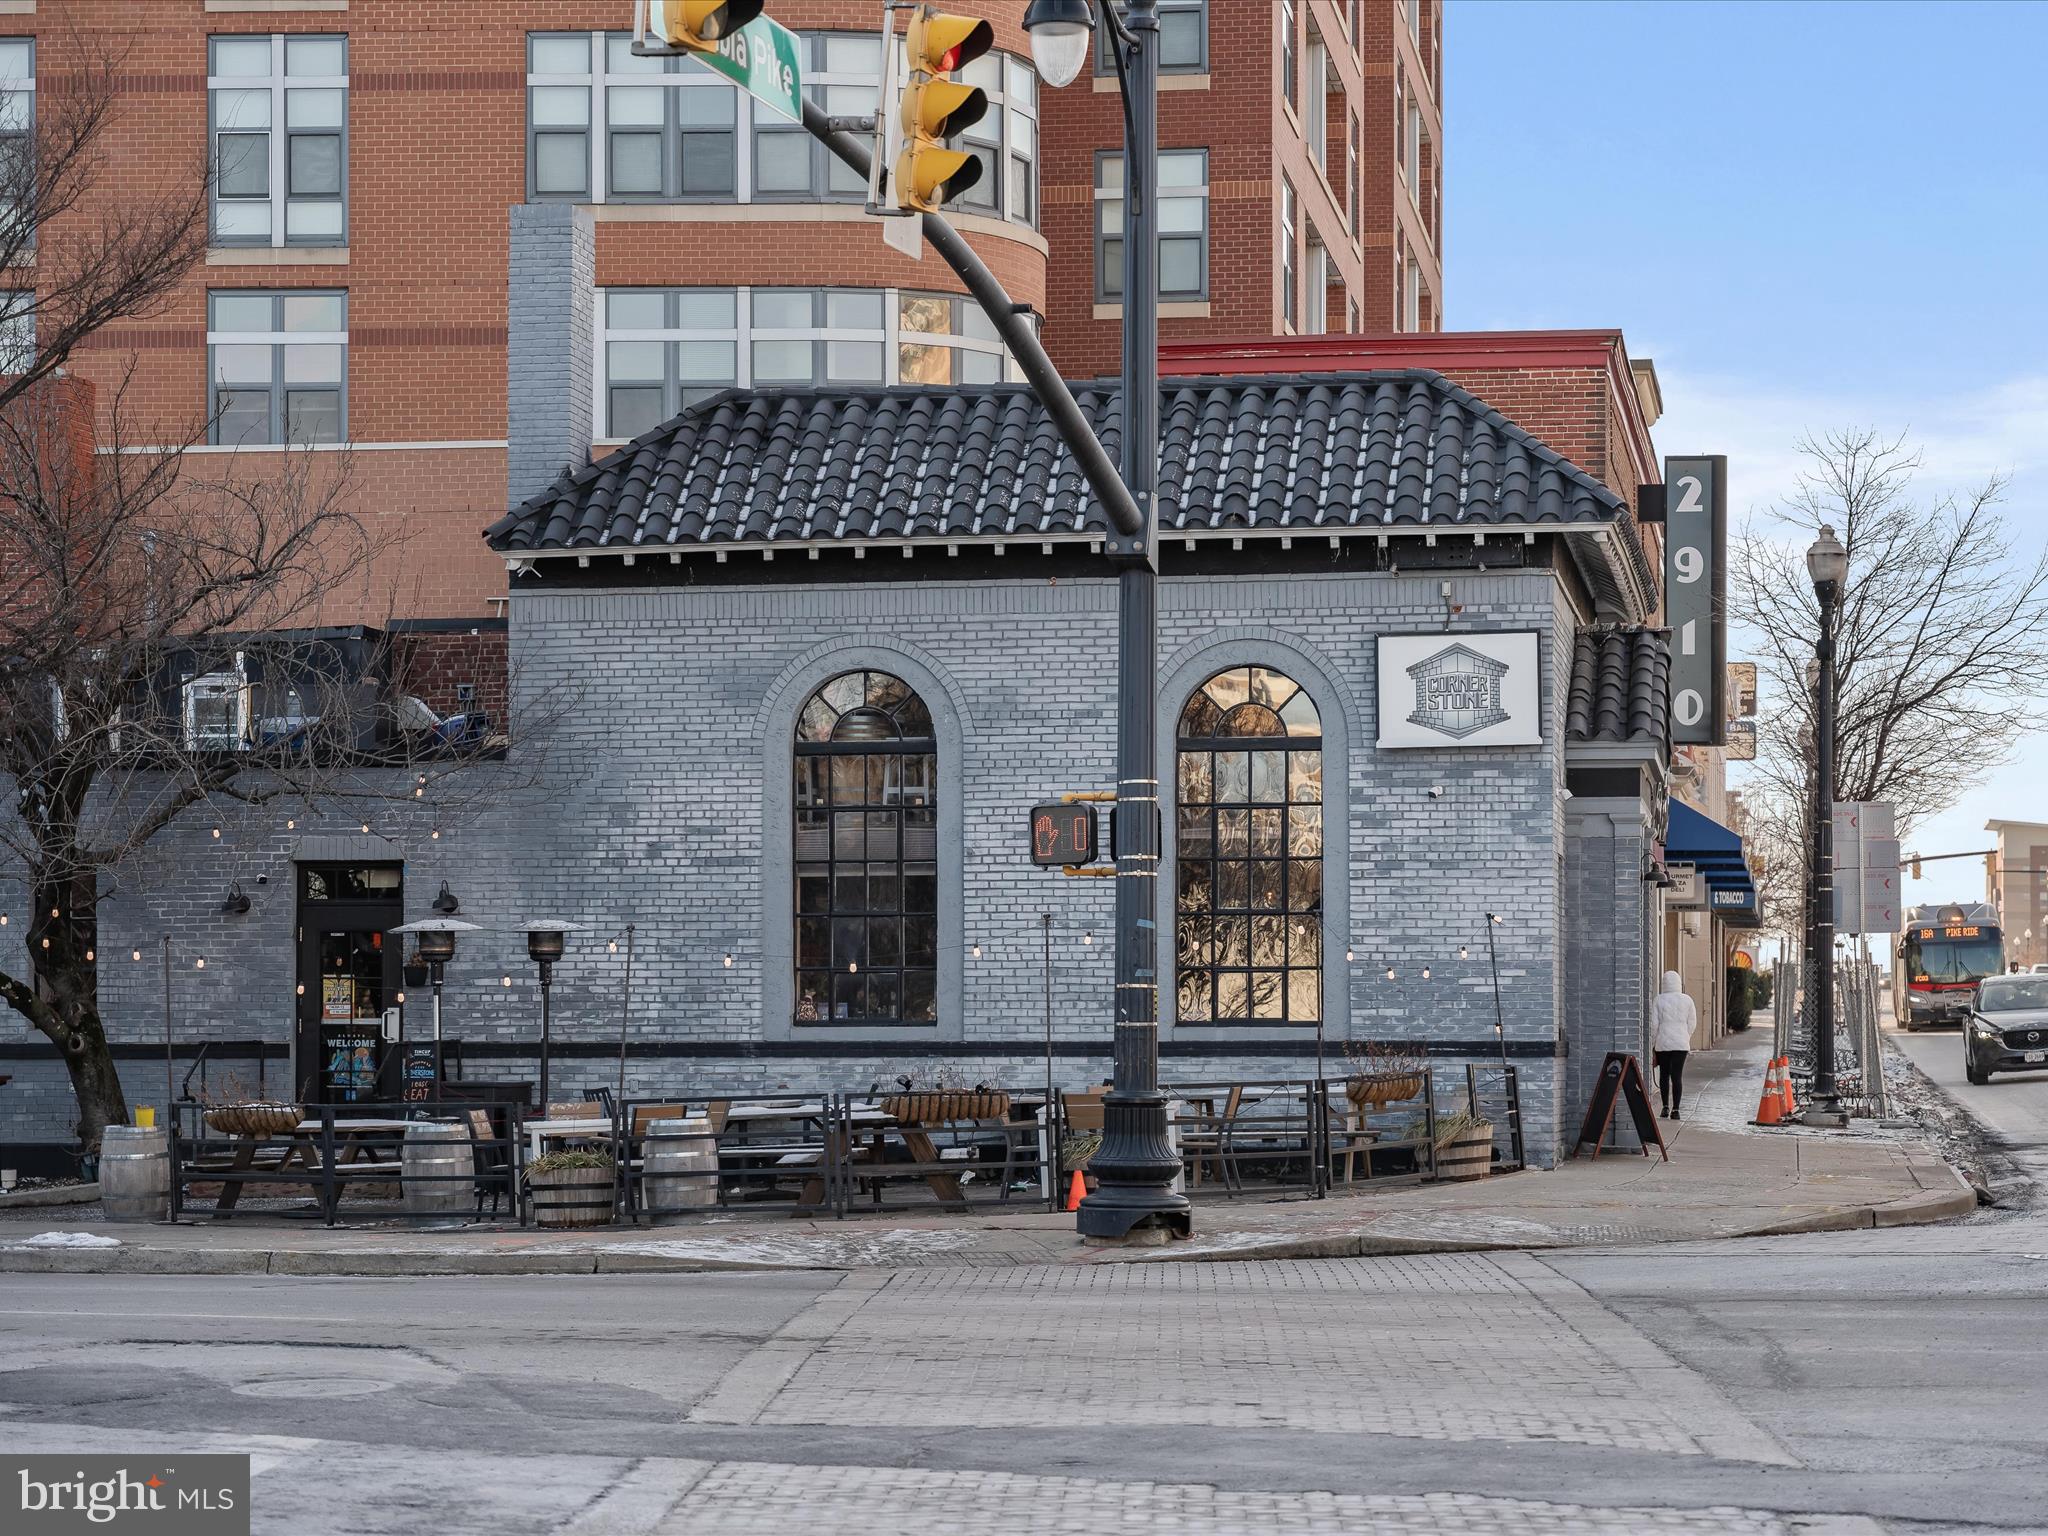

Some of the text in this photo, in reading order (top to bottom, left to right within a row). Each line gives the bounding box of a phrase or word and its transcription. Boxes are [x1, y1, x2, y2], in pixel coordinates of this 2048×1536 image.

[753, 35, 794, 97] Pike
[1673, 475, 1704, 727] 2910
[1427, 673, 1489, 694] CORNER
[1427, 692, 1490, 711] STONE
[1714, 891, 1745, 904] & TOBACCO
[1920, 926, 1980, 939] 16A PIKE RIDE
[327, 1039, 376, 1048] WELCOME
